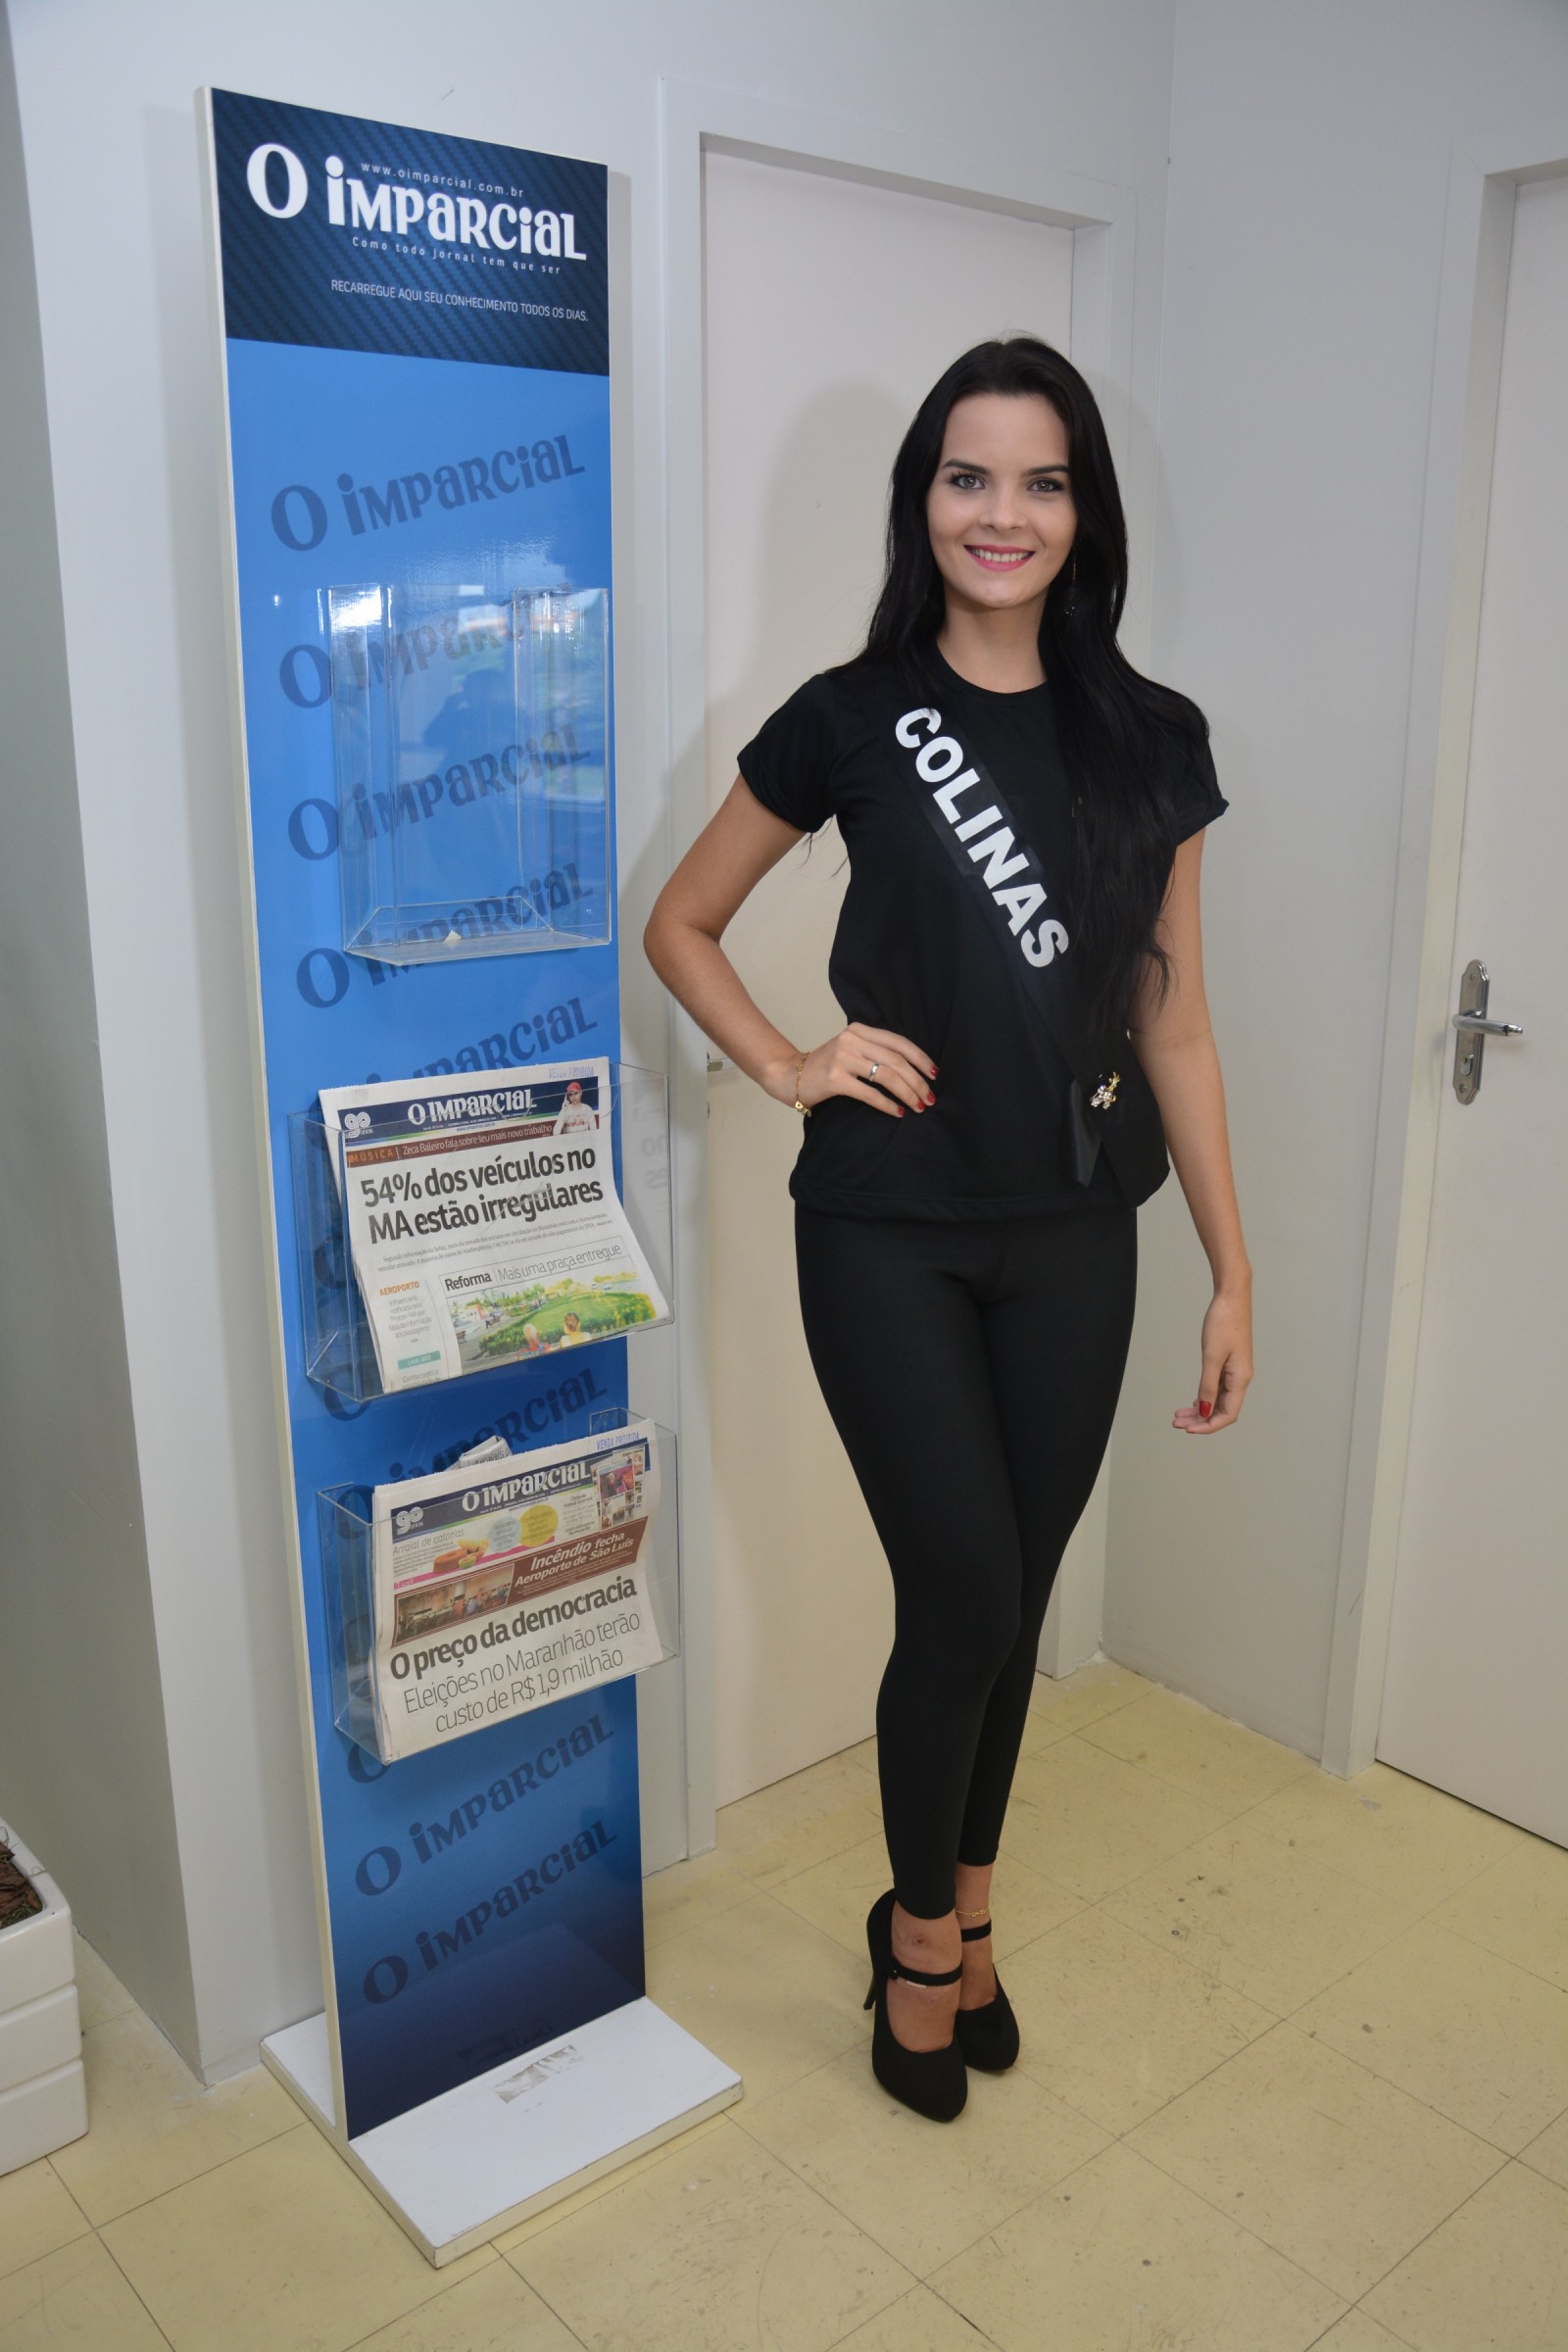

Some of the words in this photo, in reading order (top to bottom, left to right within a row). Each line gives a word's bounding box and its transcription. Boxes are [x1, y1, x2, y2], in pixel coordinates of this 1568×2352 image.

[247, 143, 308, 219] O
[361, 162, 524, 198] www.oimparcial.com.br
[353, 236, 388, 252] Como
[395, 242, 425, 256] todo
[432, 245, 475, 264] jornal
[482, 254, 505, 267] tem
[513, 261, 533, 273] que
[541, 265, 561, 274] ser
[330, 279, 396, 300] RECARREGUE
[398, 287, 422, 303] AQUI
[424, 289, 443, 304] SEU
[445, 292, 518, 314] CONHECIMENTO
[520, 302, 551, 317] TODOS
[552, 306, 565, 318] OS
[565, 307, 589, 321] DIAS.
[270, 485, 328, 551] O
[279, 644, 332, 709] O
[287, 798, 340, 860] O
[895, 707, 1069, 968] COLINAS
[296, 948, 350, 1008] O
[403, 1143, 418, 1155] Zeca
[419, 1139, 444, 1152] Baleiro
[444, 1137, 459, 1150] fala
[459, 1134, 477, 1147] sobre
[478, 1133, 490, 1144] seu
[490, 1130, 507, 1142] mais
[507, 1129, 523, 1139] novo
[524, 1123, 553, 1137] trabalho
[408, 1103, 425, 1125] O
[361, 1172, 422, 1207] 54%
[424, 1167, 467, 1197] dos
[468, 1151, 565, 1189] veículos
[566, 1148, 595, 1172] no
[368, 1209, 415, 1245] MA
[415, 1200, 478, 1235] estão
[479, 1180, 604, 1223] irregulares
[379, 1281, 419, 1297] AEROPORTO
[445, 1272, 492, 1291] Reforma
[498, 1267, 520, 1282] Mais
[523, 1262, 546, 1277] uma
[547, 1256, 575, 1274] praça
[575, 1244, 622, 1265] entregue
[597, 1439, 614, 1450] VENDA
[462, 1492, 480, 1512] O
[422, 1538, 431, 1546] de
[515, 1560, 571, 1588] Aeroporto
[573, 1555, 586, 1565] de
[590, 1547, 610, 1560] São
[612, 1538, 634, 1552] Luís
[531, 1541, 592, 1571] Incêndio
[596, 1533, 624, 1548] fecha
[391, 1652, 410, 1680] O
[415, 1635, 477, 1680] preço
[481, 1622, 511, 1648] da
[513, 1576, 637, 1632] democracia
[404, 1669, 478, 1713] Eleições
[481, 1665, 504, 1686] no
[507, 1630, 596, 1677] Maranhão
[597, 1611, 640, 1642] terão
[436, 1699, 483, 1733] custo
[487, 1690, 508, 1714] de
[512, 1677, 535, 1704] R$
[539, 1669, 561, 1698] 1,9
[564, 1648, 623, 1685] milhão
[355, 1846, 402, 1896] O
[363, 1955, 409, 2004] O
